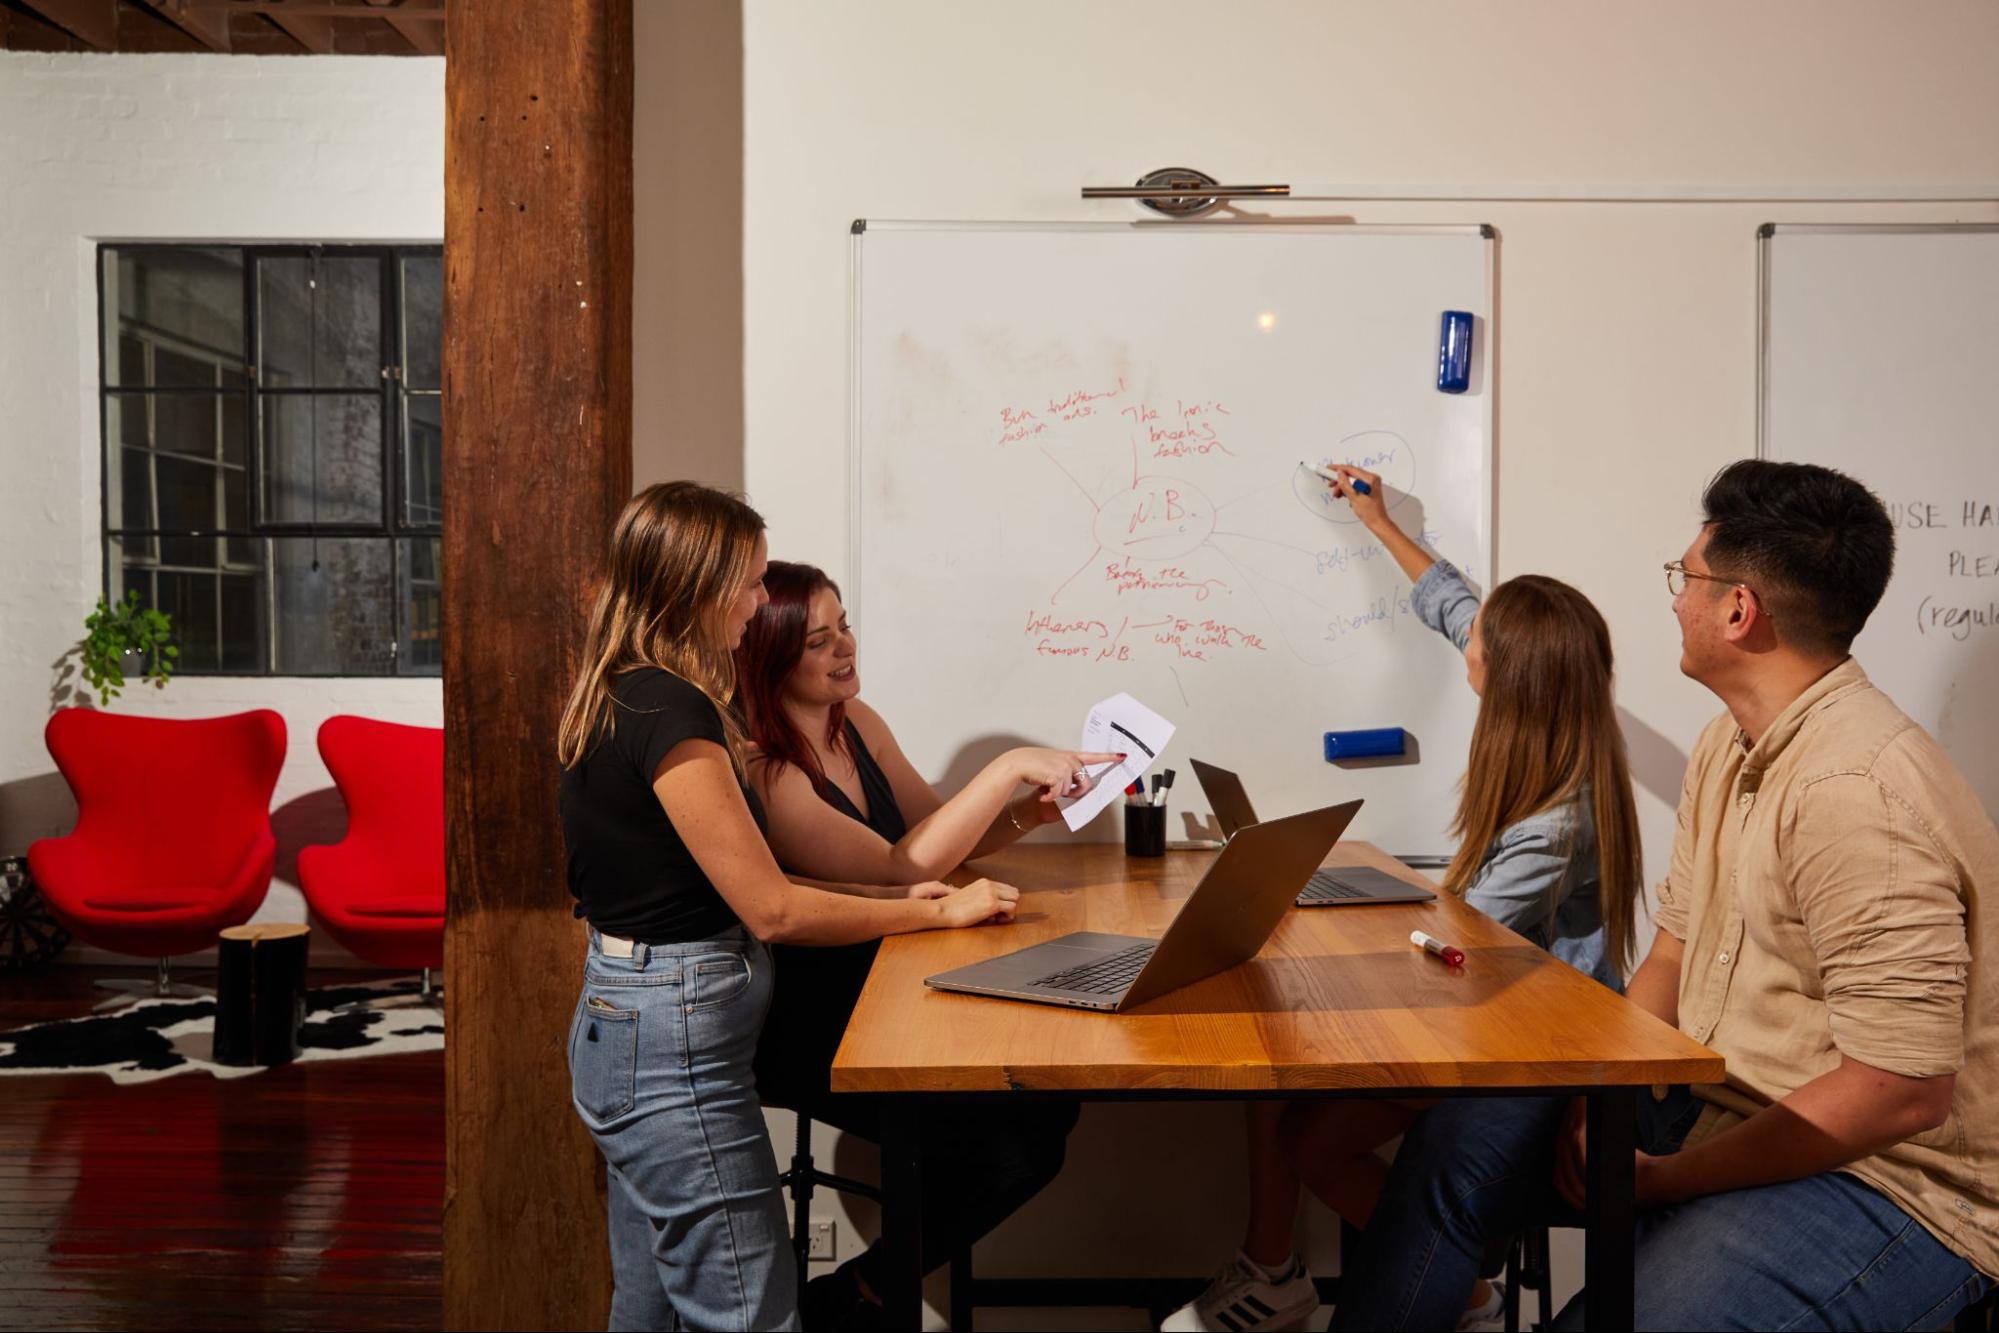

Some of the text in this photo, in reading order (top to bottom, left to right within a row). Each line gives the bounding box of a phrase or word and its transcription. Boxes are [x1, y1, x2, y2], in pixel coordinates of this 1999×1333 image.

[1120, 404, 1161, 425] The
[1148, 420, 1218, 443] breaks
[1152, 438, 1237, 459] fashion
[1961, 499, 1999, 528] HA
[1194, 632, 1233, 648] walk
